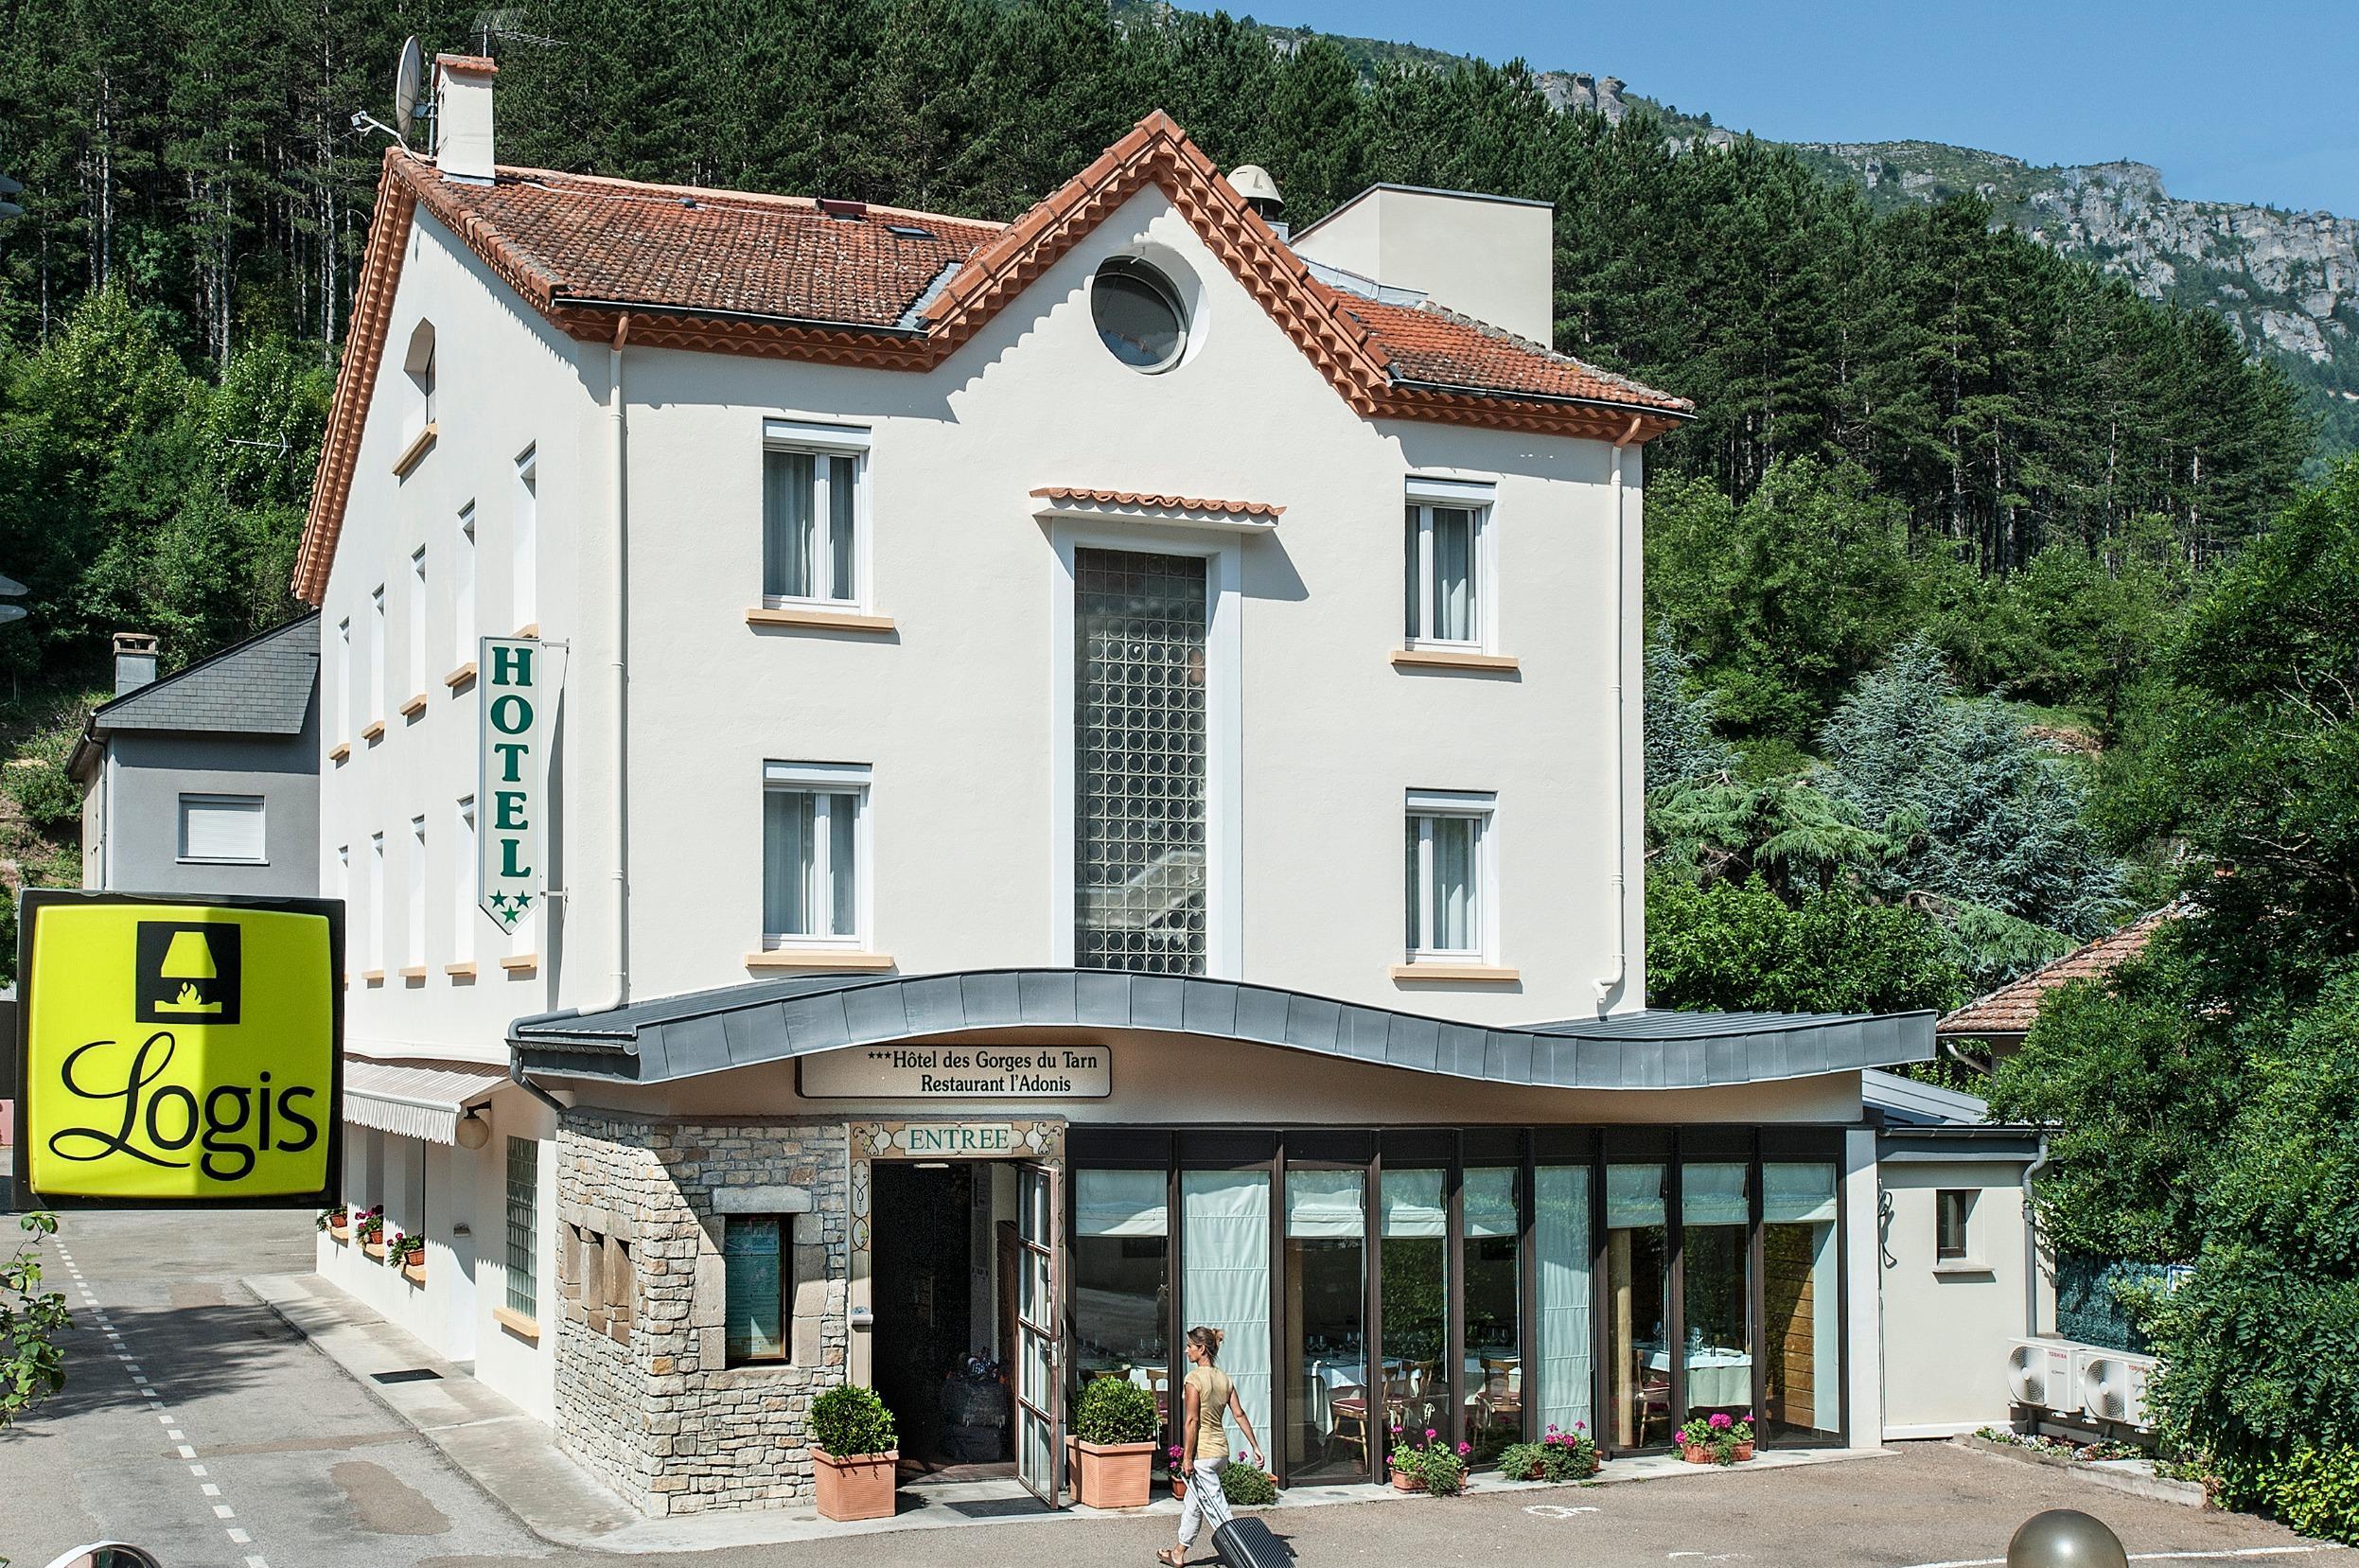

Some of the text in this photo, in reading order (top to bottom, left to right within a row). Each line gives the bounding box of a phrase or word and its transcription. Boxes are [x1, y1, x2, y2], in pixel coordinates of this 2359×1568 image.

[490, 645, 534, 878] HOTEL
[942, 1050, 970, 1068] des
[976, 1051, 1031, 1071] Gorges
[1036, 1050, 1057, 1068] du
[1062, 1050, 1098, 1068] Tarn
[921, 1074, 1071, 1092] Restaurant l'Adonis
[49, 1031, 318, 1182] Logis
[909, 1129, 1010, 1150] ENTREE
